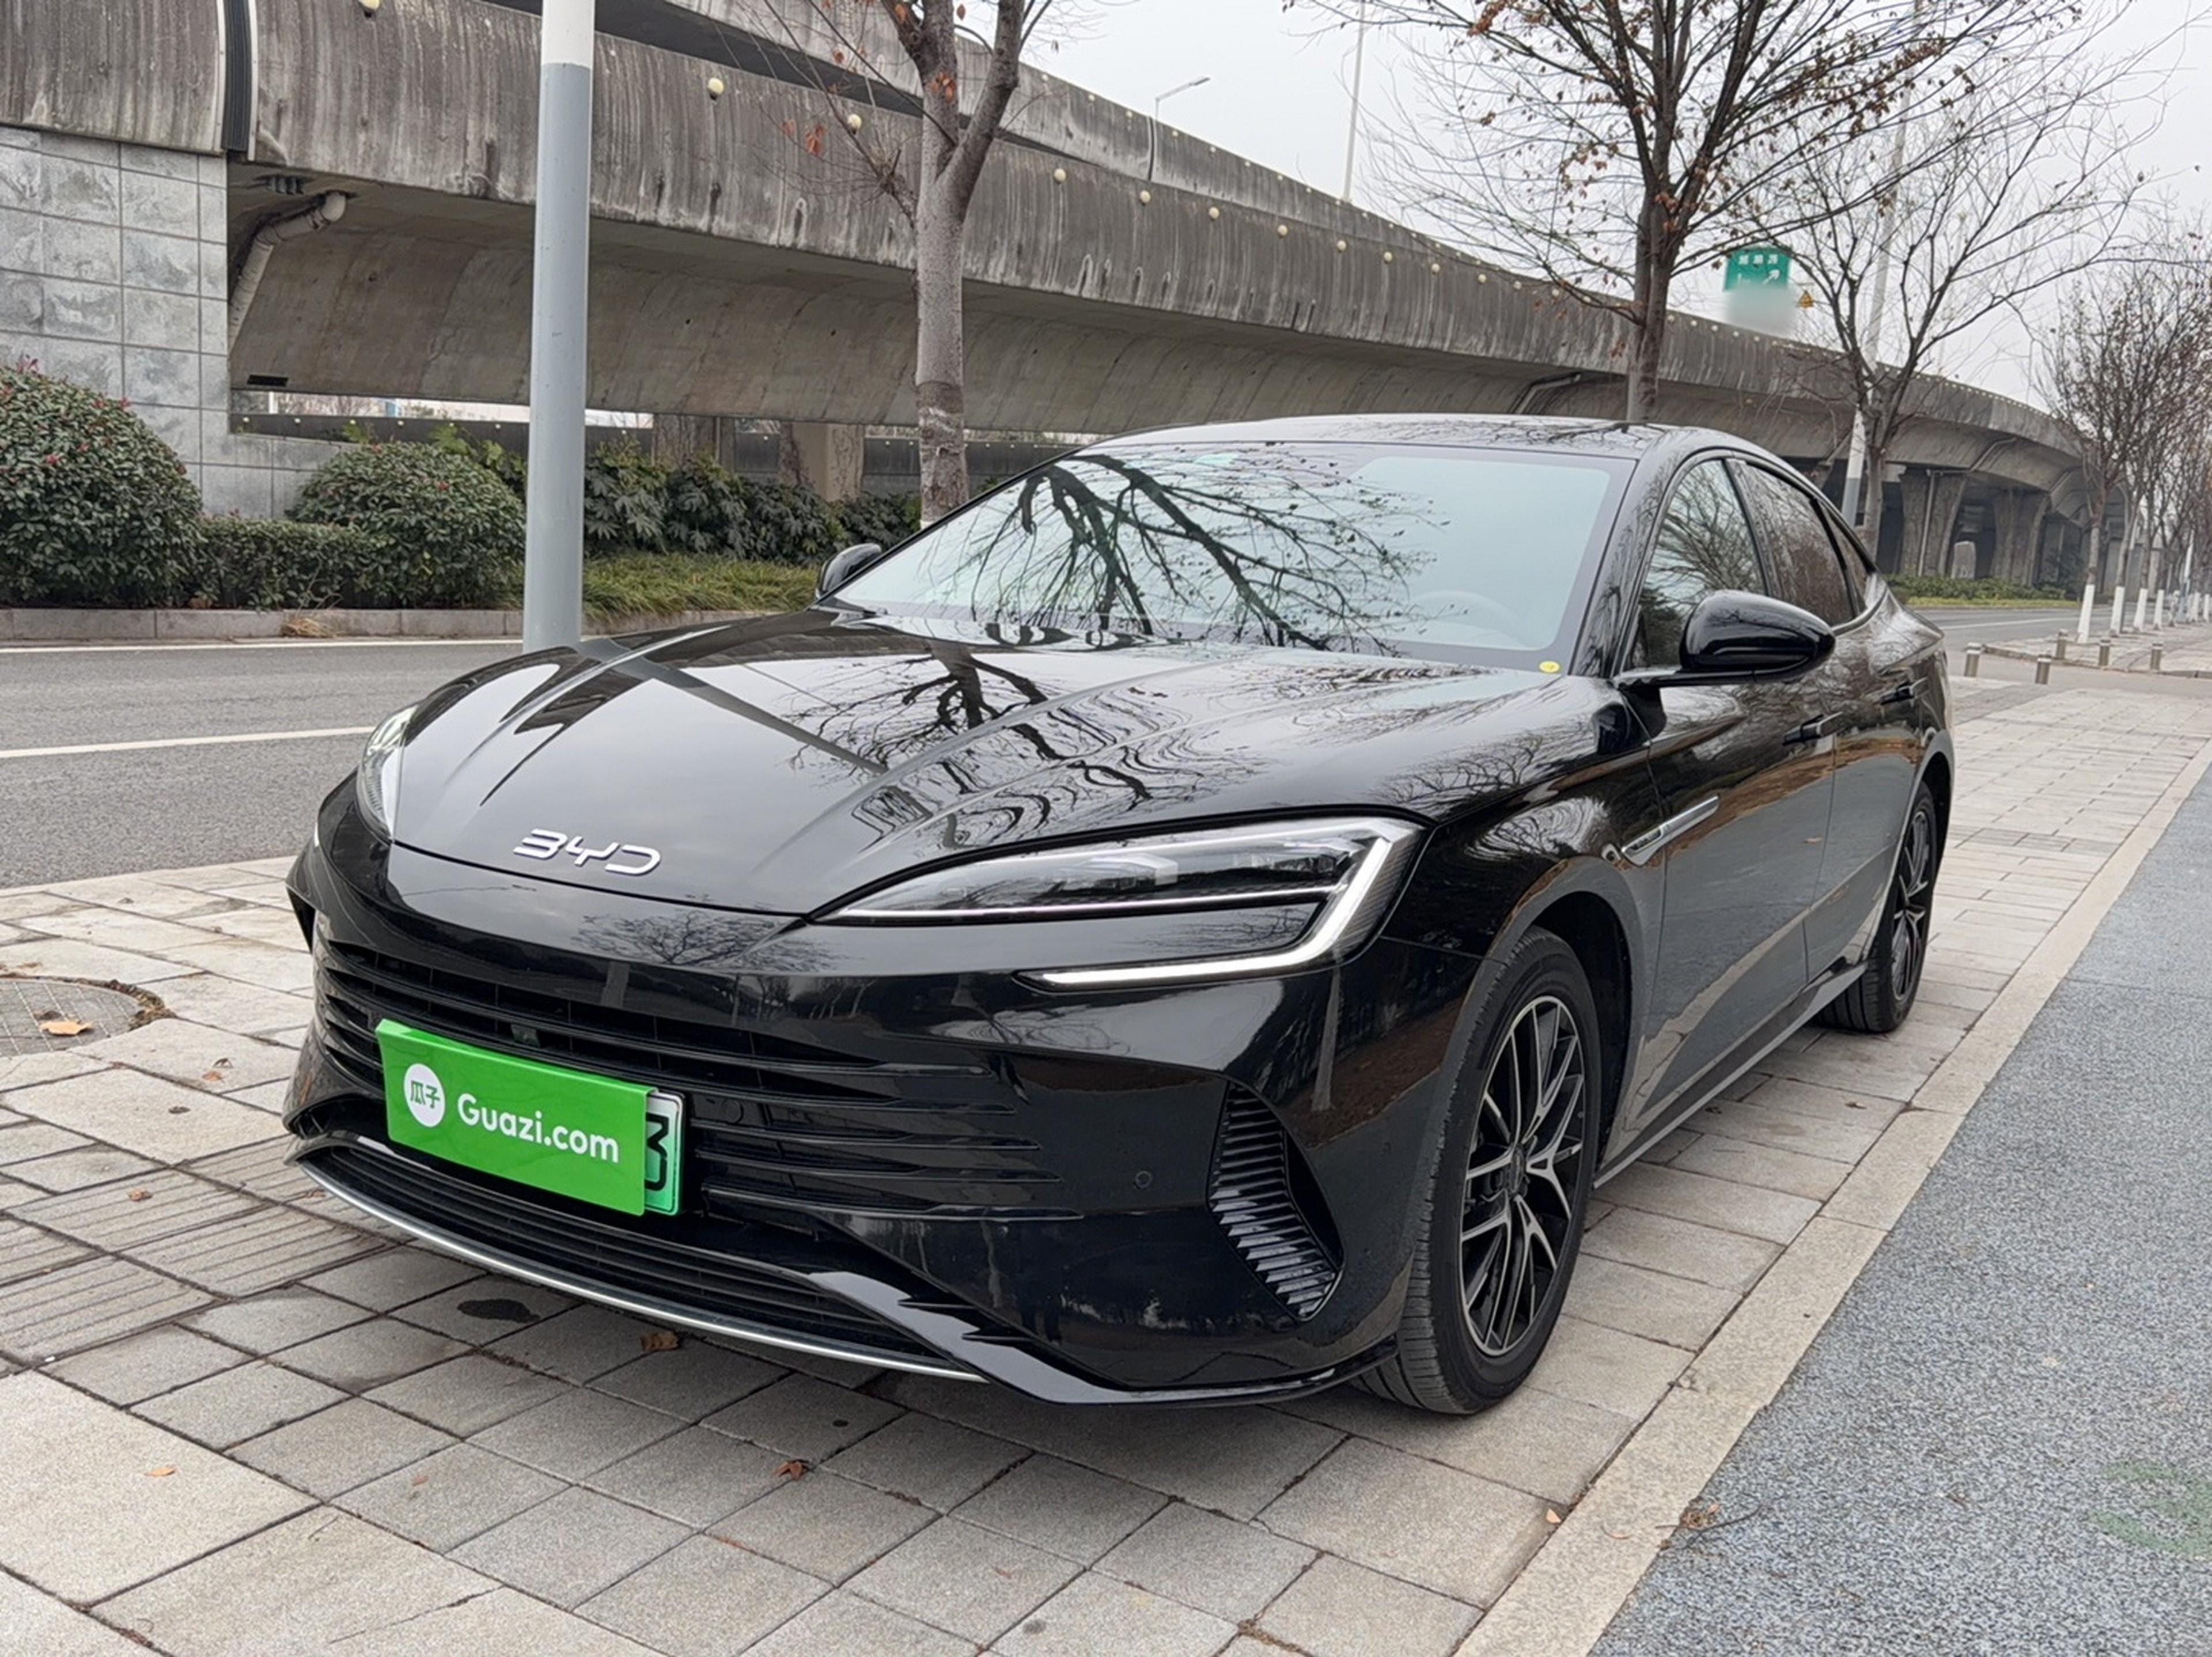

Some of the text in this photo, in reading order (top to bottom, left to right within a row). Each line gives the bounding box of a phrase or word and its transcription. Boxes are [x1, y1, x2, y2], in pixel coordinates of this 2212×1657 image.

[513, 828, 661, 875] BYD
[410, 1079, 441, 1109] 瓜子
[458, 1093, 619, 1163] Guazi.com
